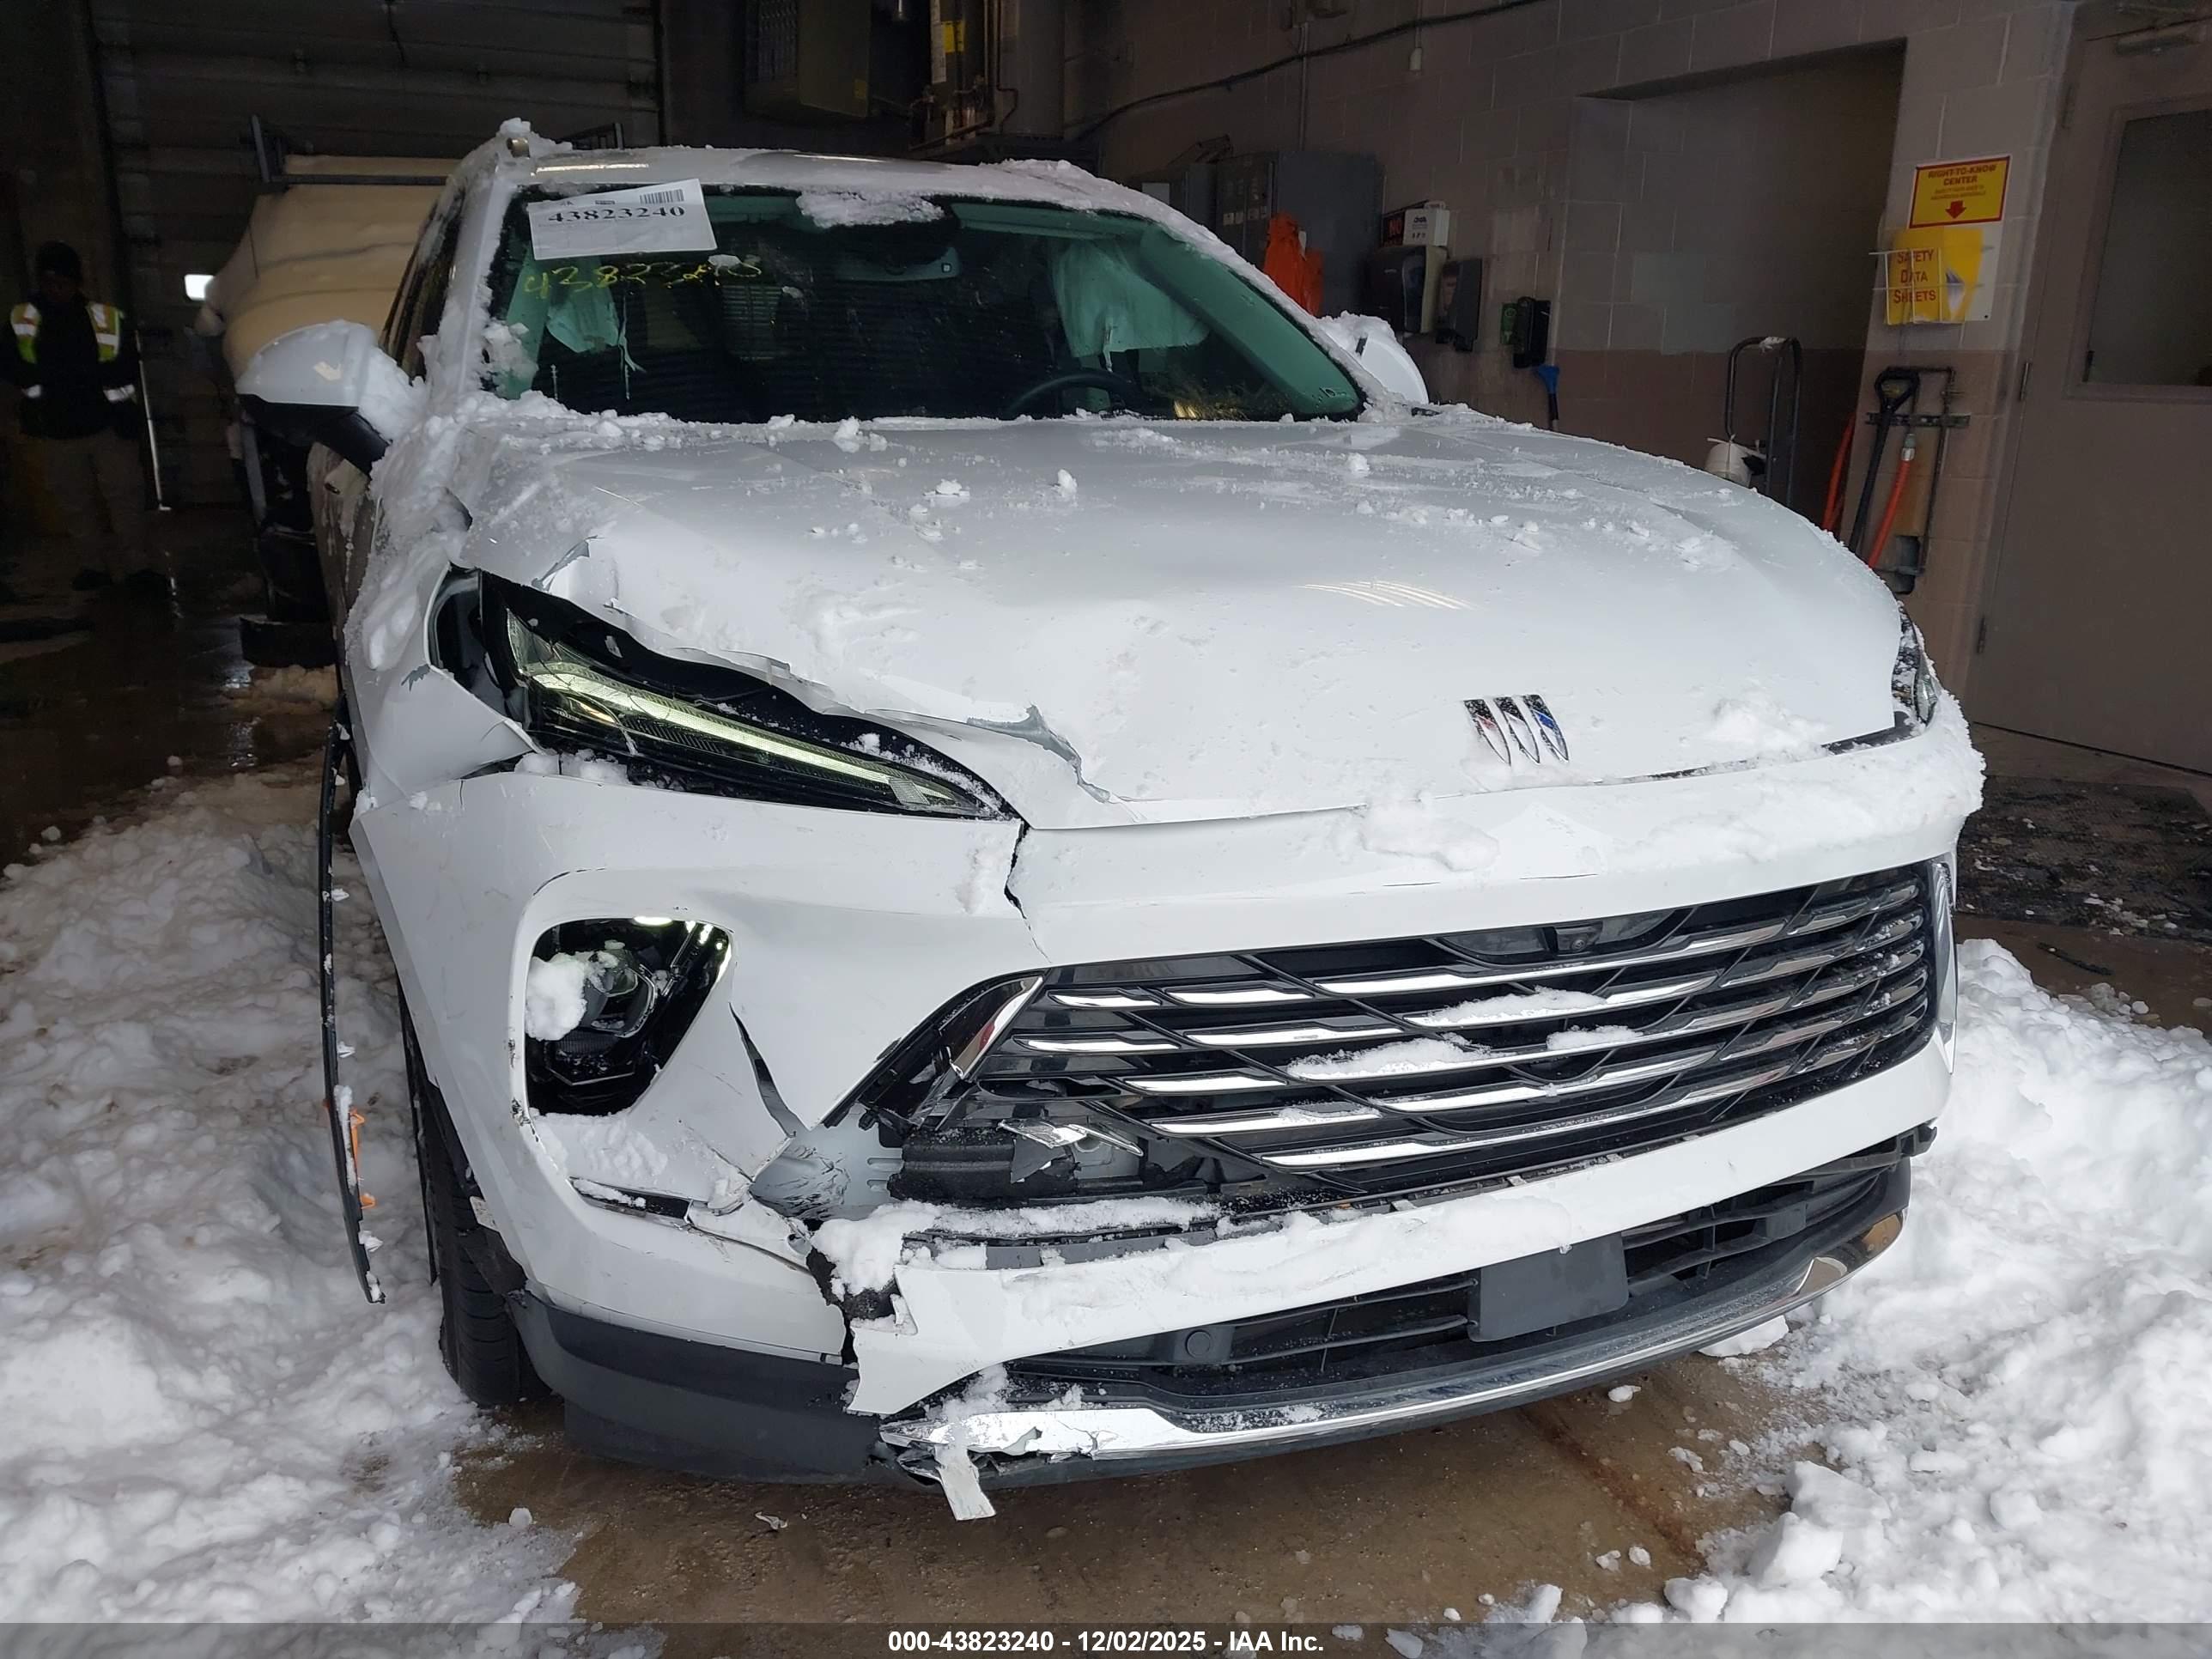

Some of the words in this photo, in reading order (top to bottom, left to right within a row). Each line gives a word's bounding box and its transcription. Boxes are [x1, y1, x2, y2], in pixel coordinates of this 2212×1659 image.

[1928, 164, 1997, 179] RIGHT-TO-KNOW
[1943, 175, 1978, 185] CENTER
[548, 205, 685, 223] 43823240
[1900, 270, 1929, 283] DATA
[1893, 289, 1937, 304] SHEETS
